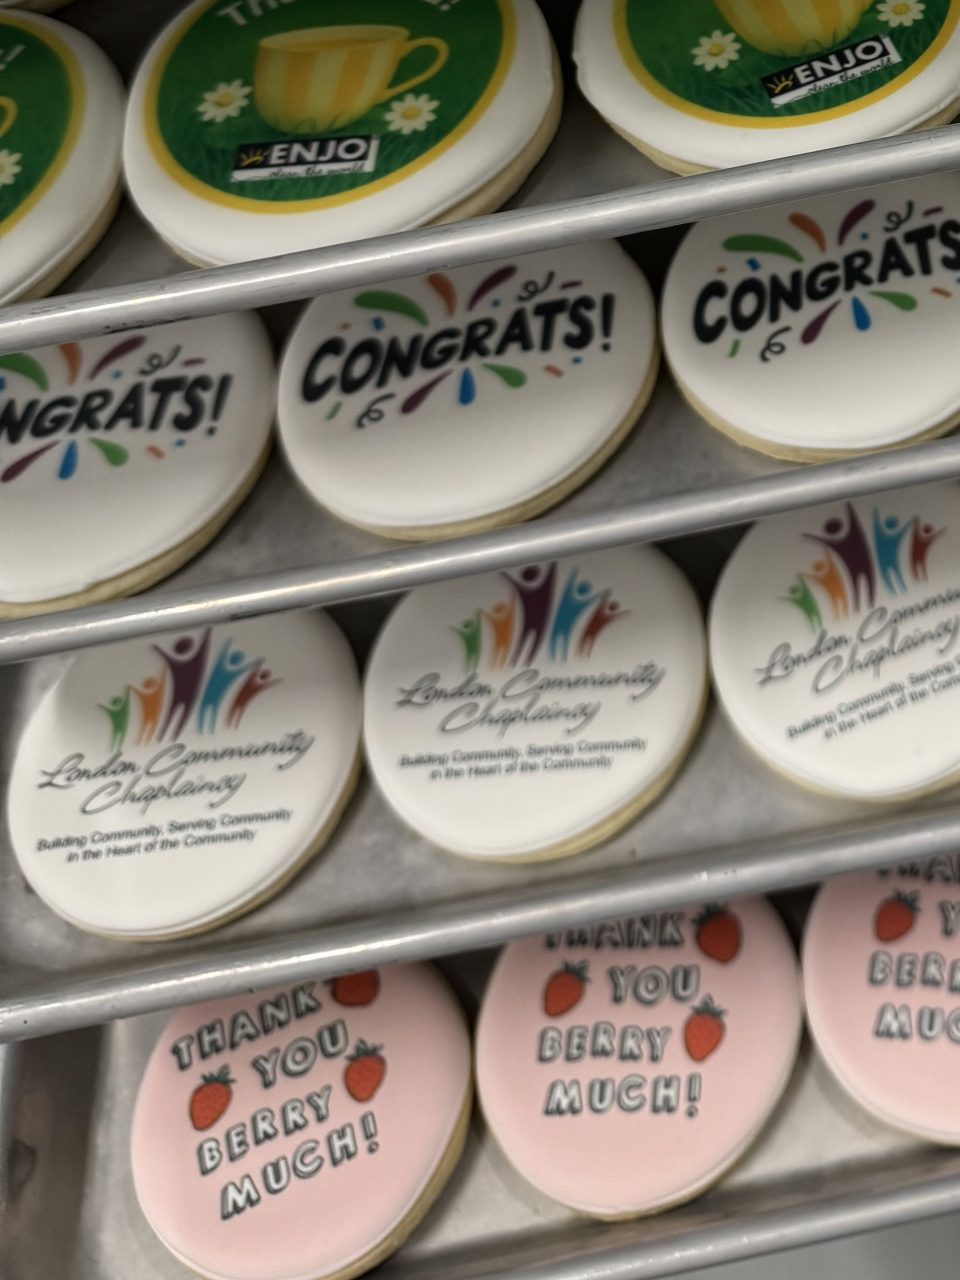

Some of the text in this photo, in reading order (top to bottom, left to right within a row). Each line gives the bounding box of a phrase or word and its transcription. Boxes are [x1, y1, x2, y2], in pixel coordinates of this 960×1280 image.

[794, 41, 883, 84] ENJO
[270, 138, 368, 165] ENJO
[301, 296, 617, 405] CONGRATS!
[754, 628, 851, 688] London
[811, 614, 960, 694] Chaplaincy
[398, 660, 666, 708] London Community
[439, 694, 602, 738] Chaplaincy
[838, 718, 857, 732] the
[909, 687, 930, 703] the
[38, 728, 315, 790] London Community
[400, 753, 449, 767] Building
[527, 744, 574, 757] Serving
[577, 738, 648, 752] Community
[445, 768, 465, 779] the
[520, 760, 540, 772] the
[543, 755, 614, 770] Community
[80, 769, 247, 816] Chaplaincy
[37, 837, 87, 851] Building
[168, 818, 217, 834] Serving
[221, 809, 294, 826] Community
[66, 830, 257, 863] in the Heart of the Community
[608, 965, 700, 1006] YOU
[172, 982, 323, 1071] THANK
[537, 1020, 672, 1063] BERRY
[252, 1019, 349, 1089] YOU
[544, 1072, 701, 1118] MUCH!
[197, 1084, 333, 1176] BERRY
[220, 1111, 379, 1221] MUCH!
